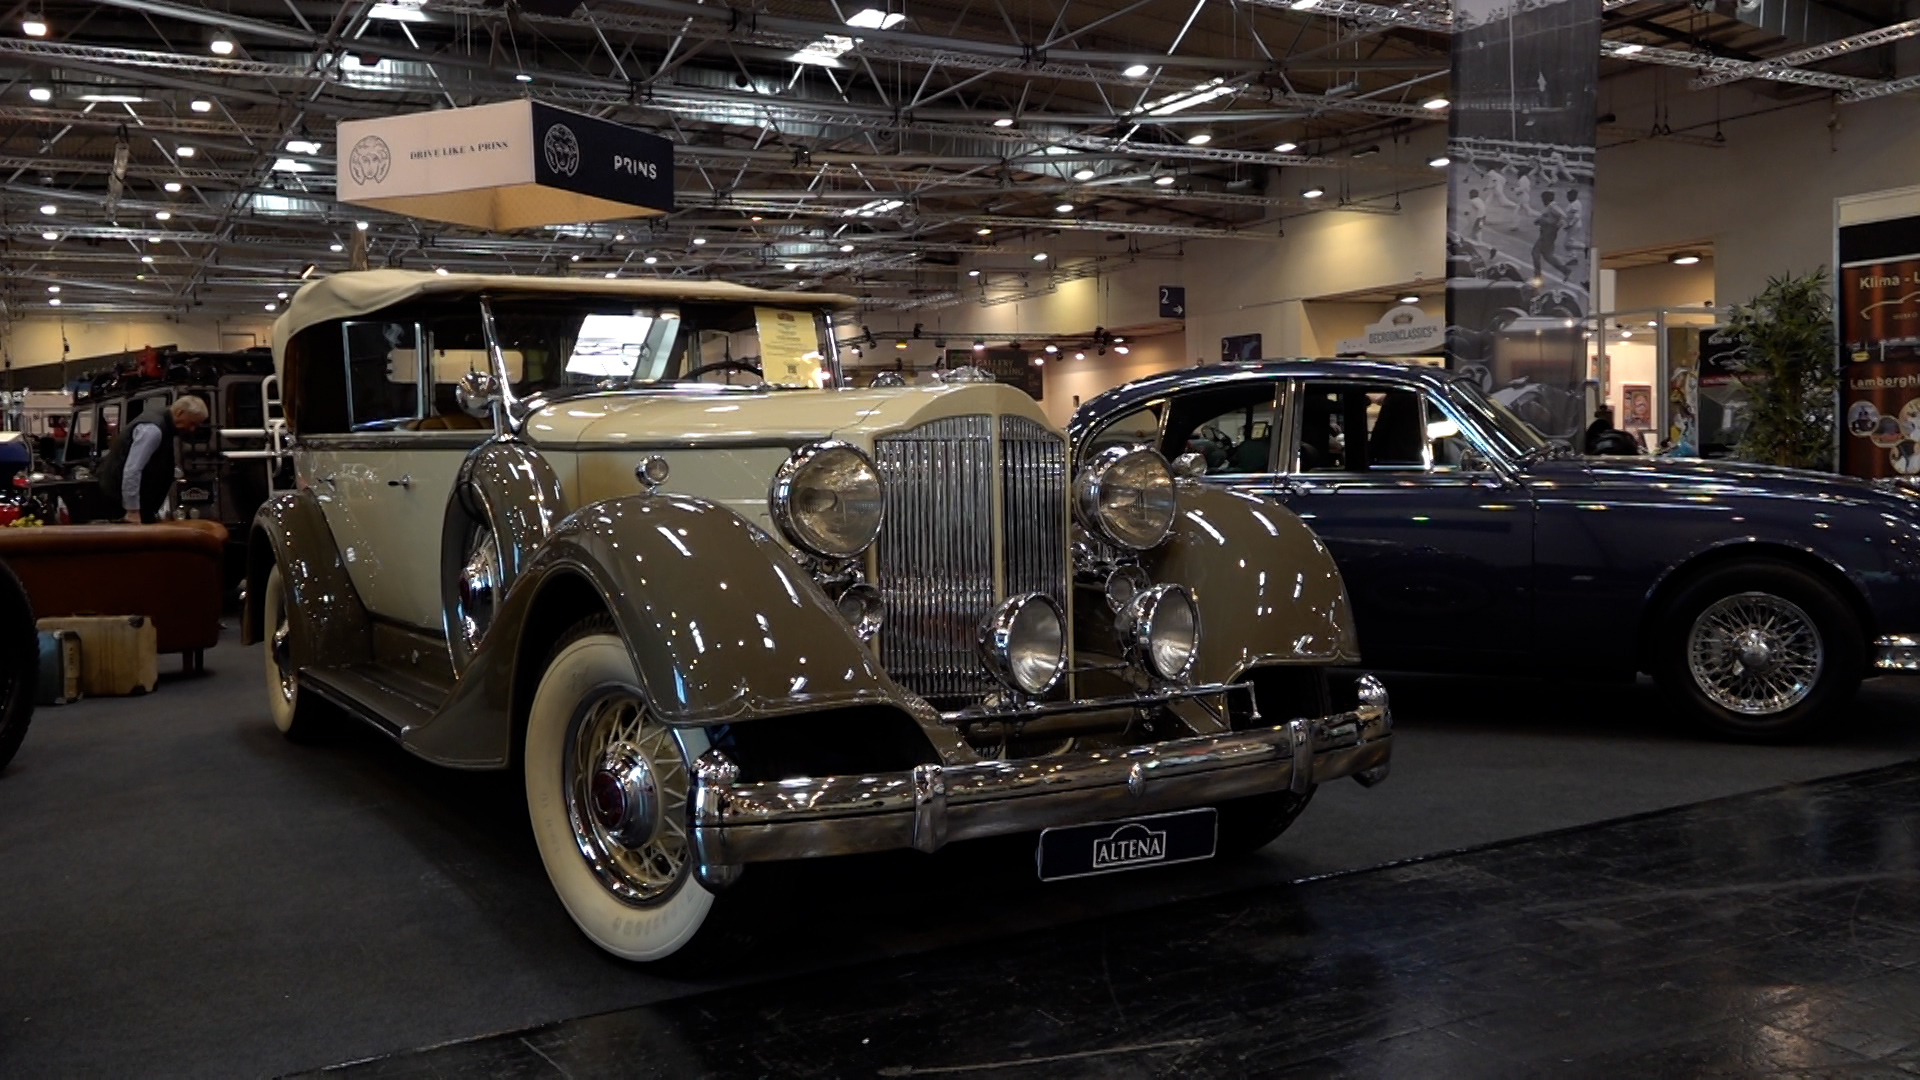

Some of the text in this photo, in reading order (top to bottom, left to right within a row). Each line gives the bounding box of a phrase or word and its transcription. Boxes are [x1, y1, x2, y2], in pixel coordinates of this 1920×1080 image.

[409, 150, 438, 160] DRIVE
[442, 147, 465, 156] LIKE
[469, 142, 476, 152] A
[614, 155, 657, 180] PRINS
[1859, 275, 1900, 289] Klima
[1161, 288, 1170, 304] 2
[1223, 340, 1231, 354] 2
[1098, 838, 1160, 862] ALTENA
